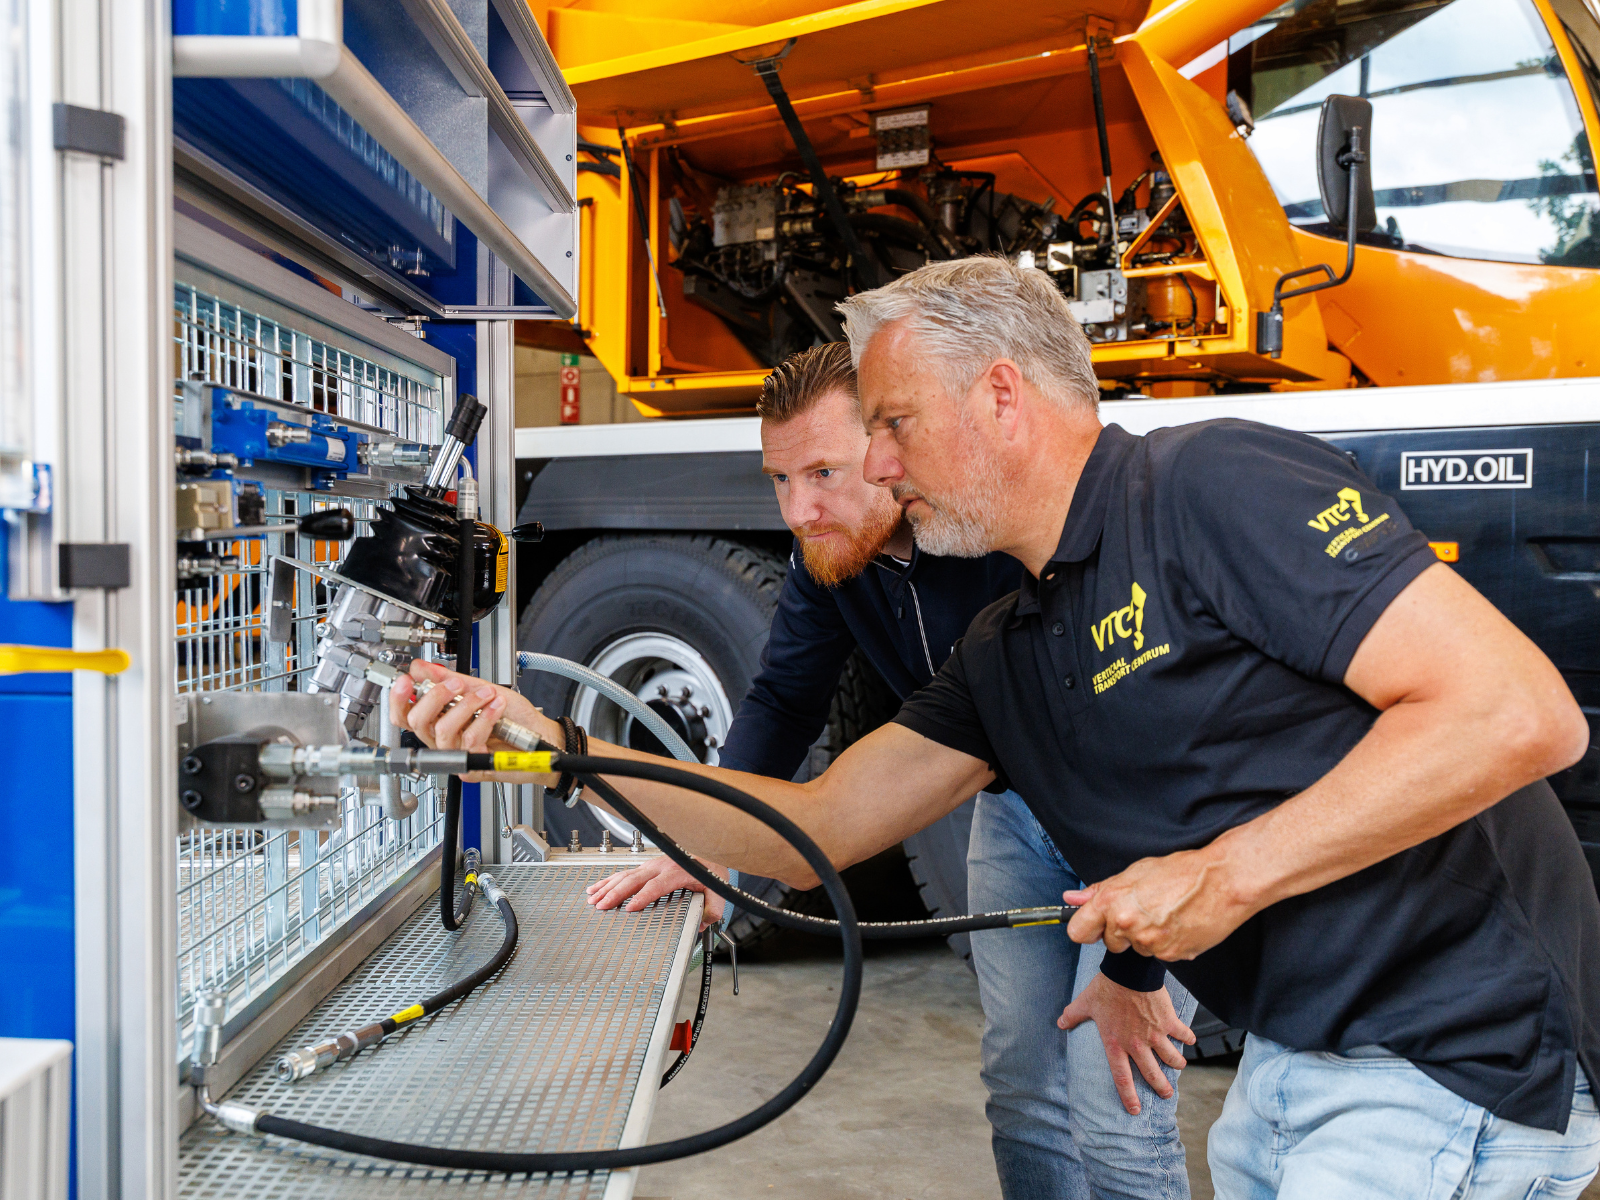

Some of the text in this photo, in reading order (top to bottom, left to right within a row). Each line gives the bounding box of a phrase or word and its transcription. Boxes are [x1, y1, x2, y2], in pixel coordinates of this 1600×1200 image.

[1407, 456, 1525, 483] HYD.OIL
[1307, 503, 1351, 533] VTC
[1091, 605, 1133, 652] VTC
[1092, 657, 1127, 685] VERTICAAL
[1094, 643, 1170, 694] TRANSPORT CENTRUM
